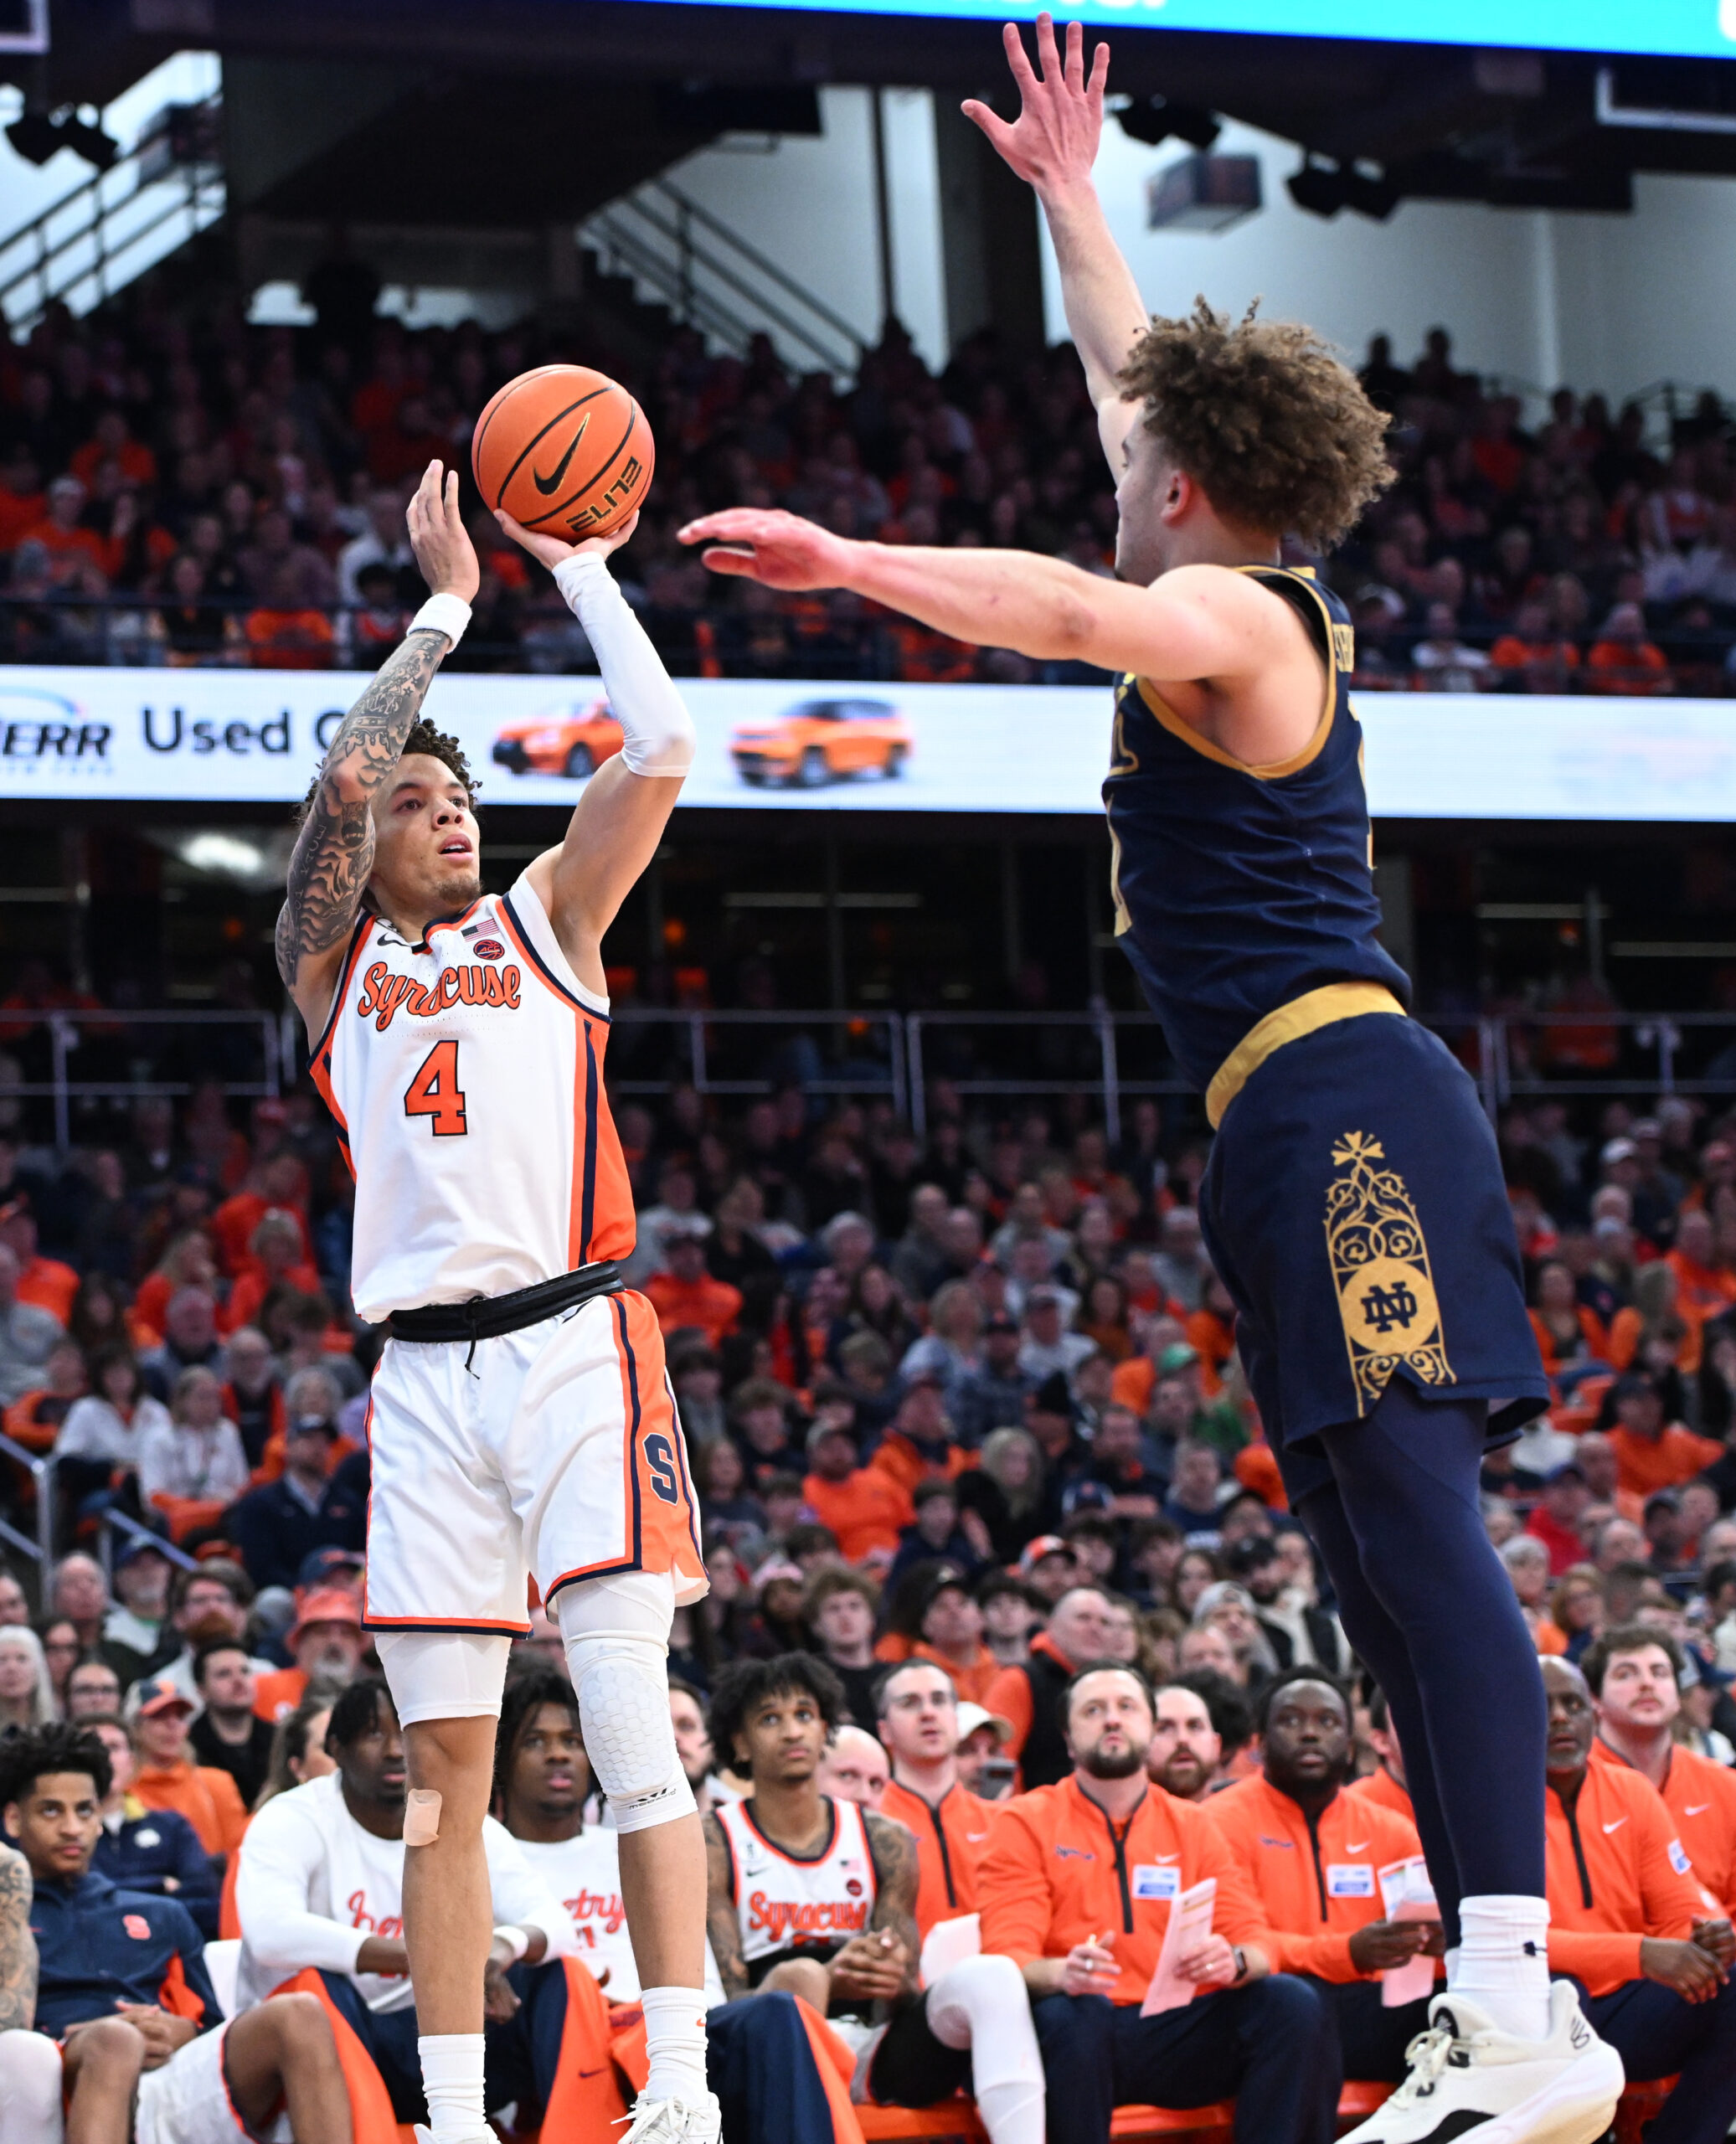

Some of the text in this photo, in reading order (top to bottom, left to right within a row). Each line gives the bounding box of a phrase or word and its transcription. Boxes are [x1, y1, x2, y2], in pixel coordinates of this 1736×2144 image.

[565, 455, 643, 533] ELITE
[143, 709, 291, 754] Used
[357, 961, 521, 1032] Syracuse
[404, 1039, 468, 1137] 4
[641, 1432, 679, 1507] S
